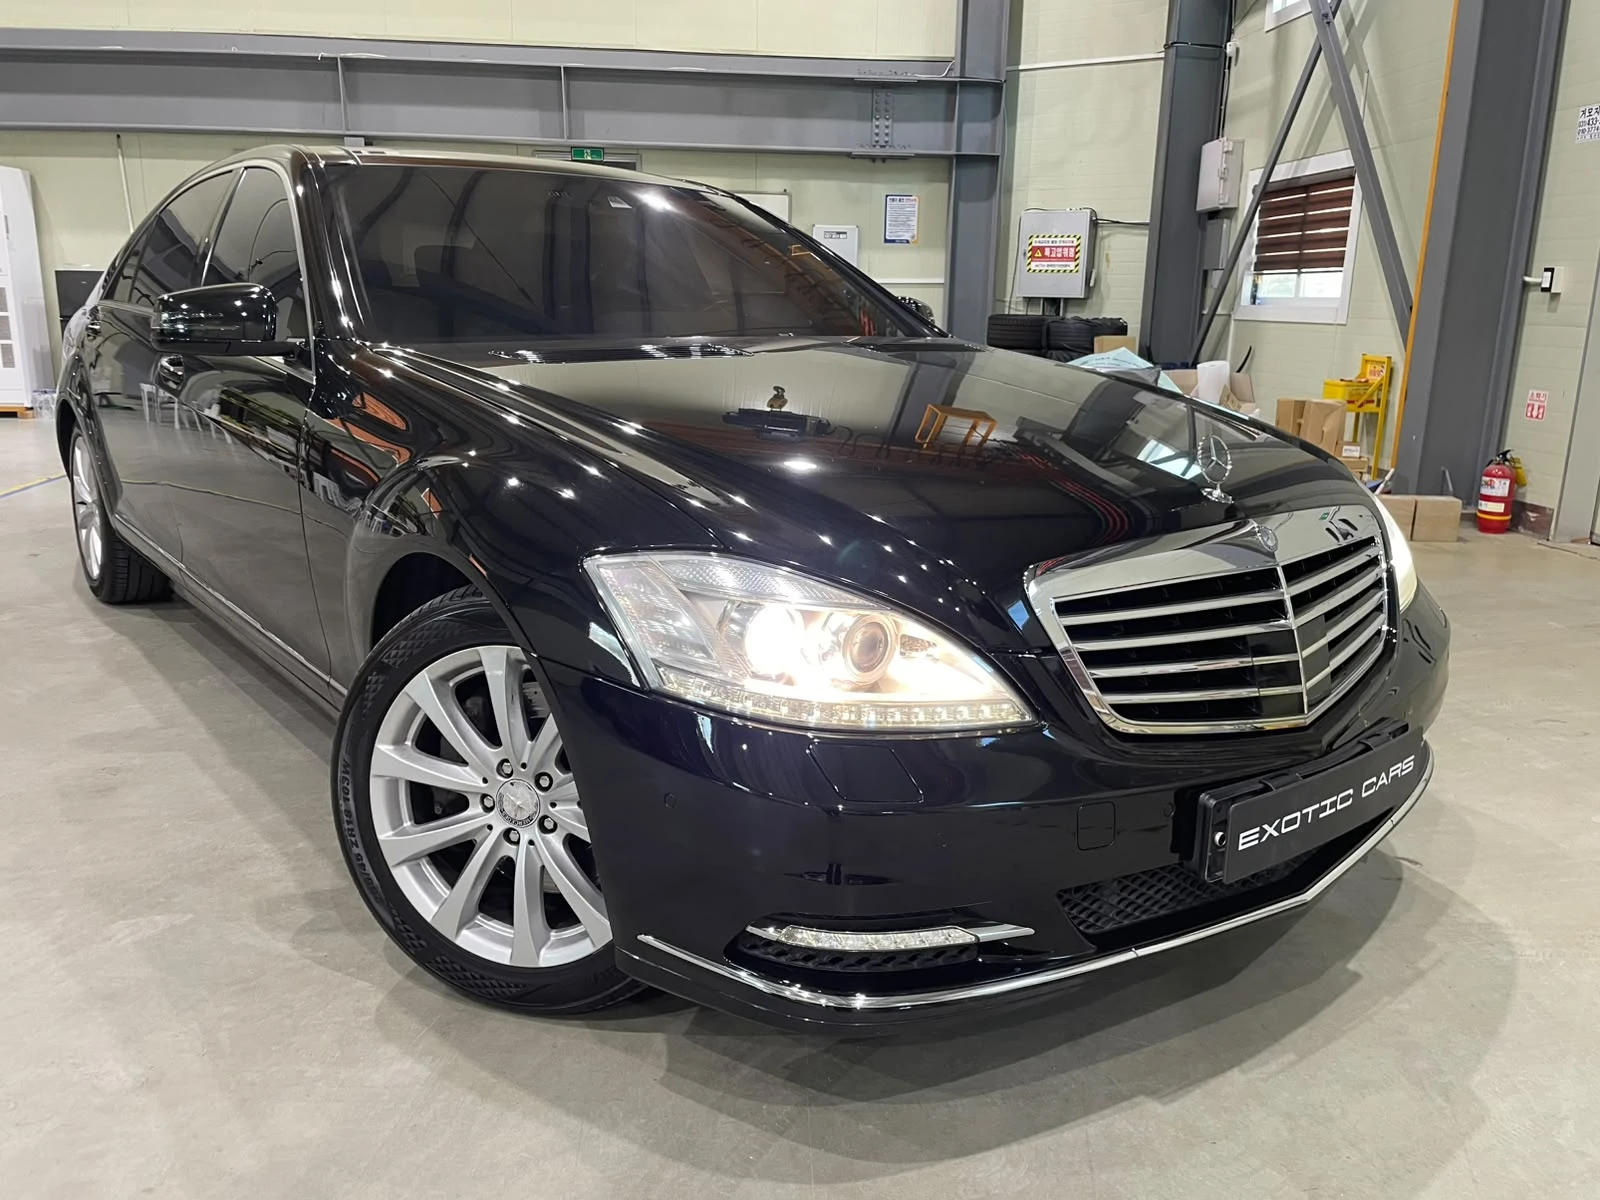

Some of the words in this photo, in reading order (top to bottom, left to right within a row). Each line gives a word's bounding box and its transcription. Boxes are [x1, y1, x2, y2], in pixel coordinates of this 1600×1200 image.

[1044, 247, 1075, 257] 특고압위험
[1238, 789, 1354, 851] EXOTIC
[1361, 755, 1415, 798] CARS
